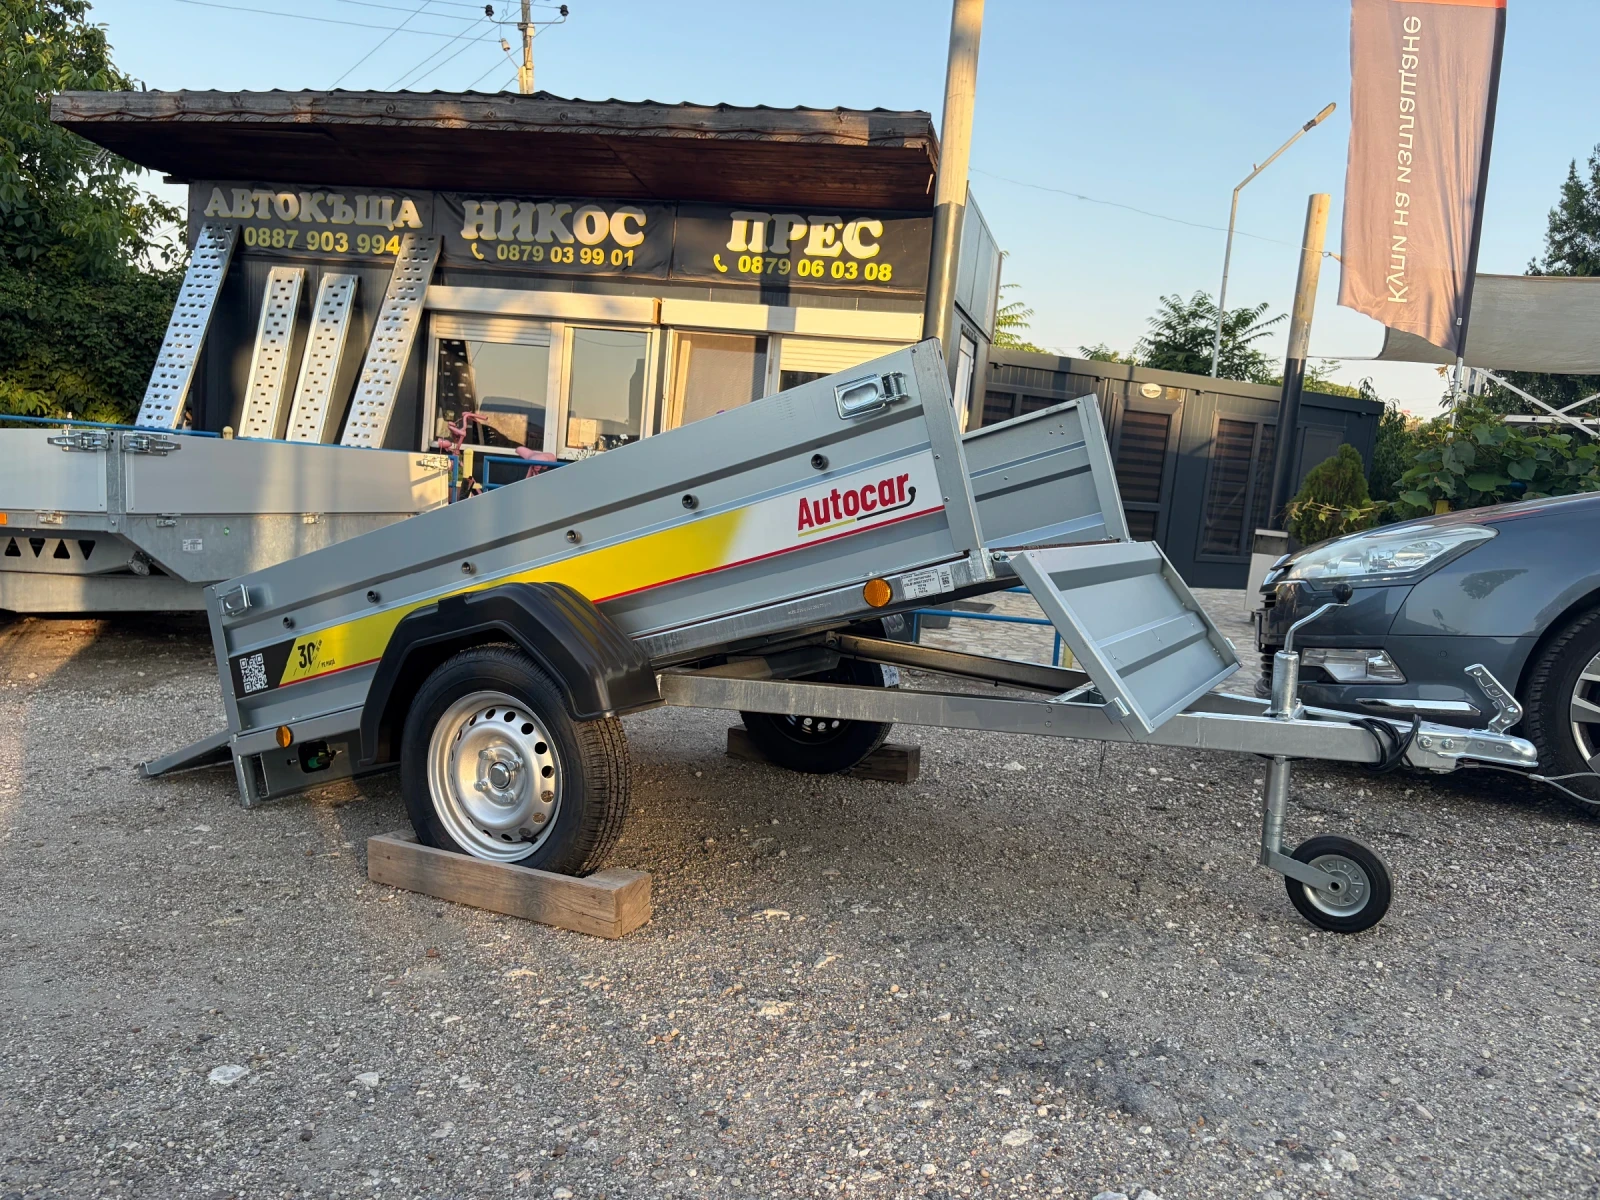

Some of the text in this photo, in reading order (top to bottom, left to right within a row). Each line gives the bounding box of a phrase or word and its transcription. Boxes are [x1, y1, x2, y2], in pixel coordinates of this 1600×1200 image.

[204, 188, 423, 230] АВТОКЪЩА
[461, 200, 647, 247] НИКОС
[243, 227, 400, 255] 0887 903 994
[496, 244, 634, 266] 0879 03 99 01
[726, 211, 883, 260] ПРЕС
[738, 255, 893, 281] 0879 06 03 08
[798, 473, 909, 531] Autocar
